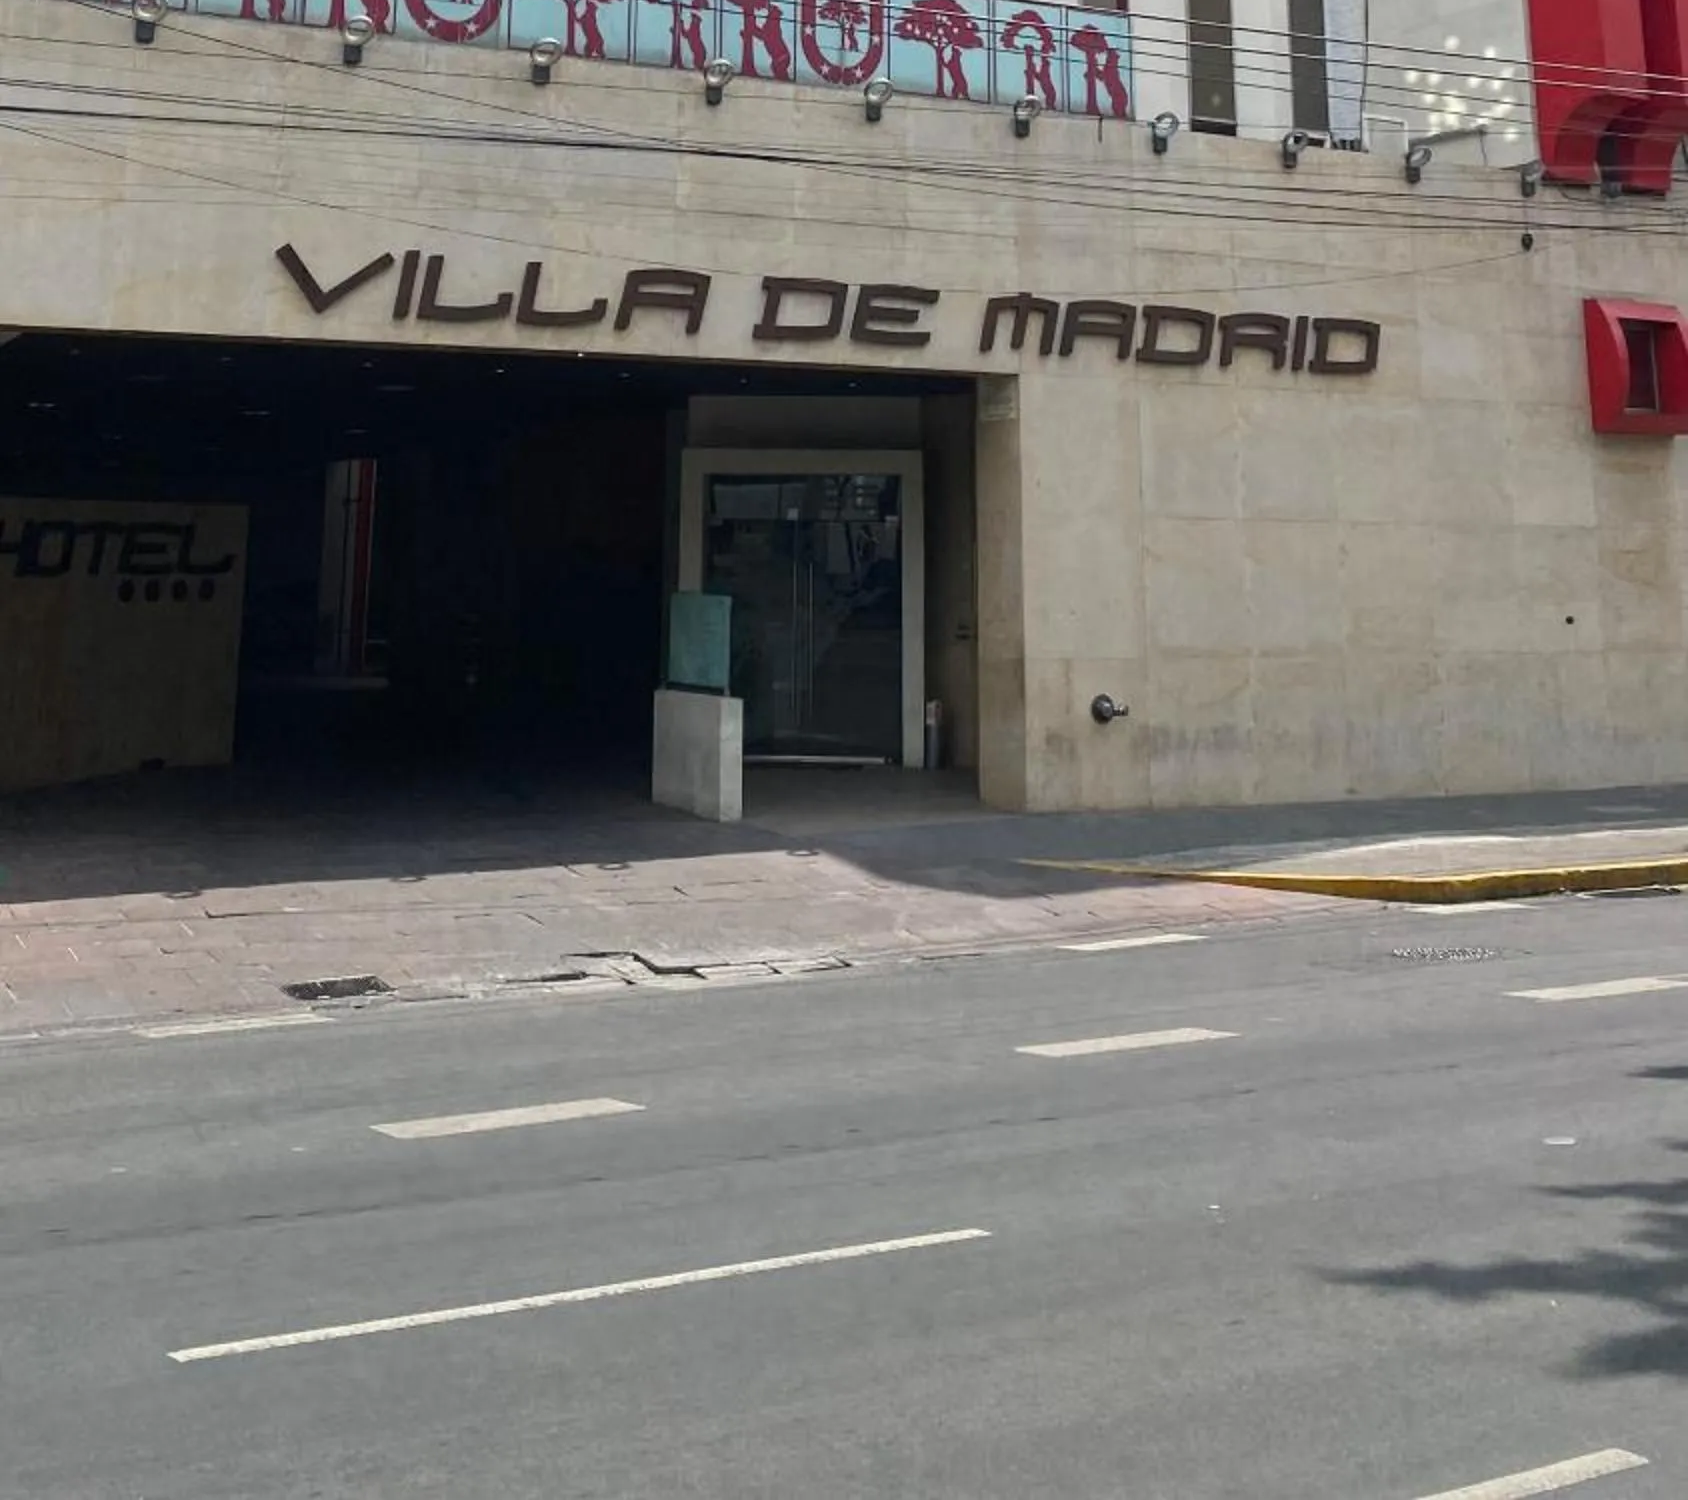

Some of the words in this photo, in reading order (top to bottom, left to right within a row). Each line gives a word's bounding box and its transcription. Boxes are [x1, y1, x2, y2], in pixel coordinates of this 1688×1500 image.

[276, 243, 712, 335] VILLA
[752, 276, 940, 347] DE
[979, 292, 1381, 376] MADRID
